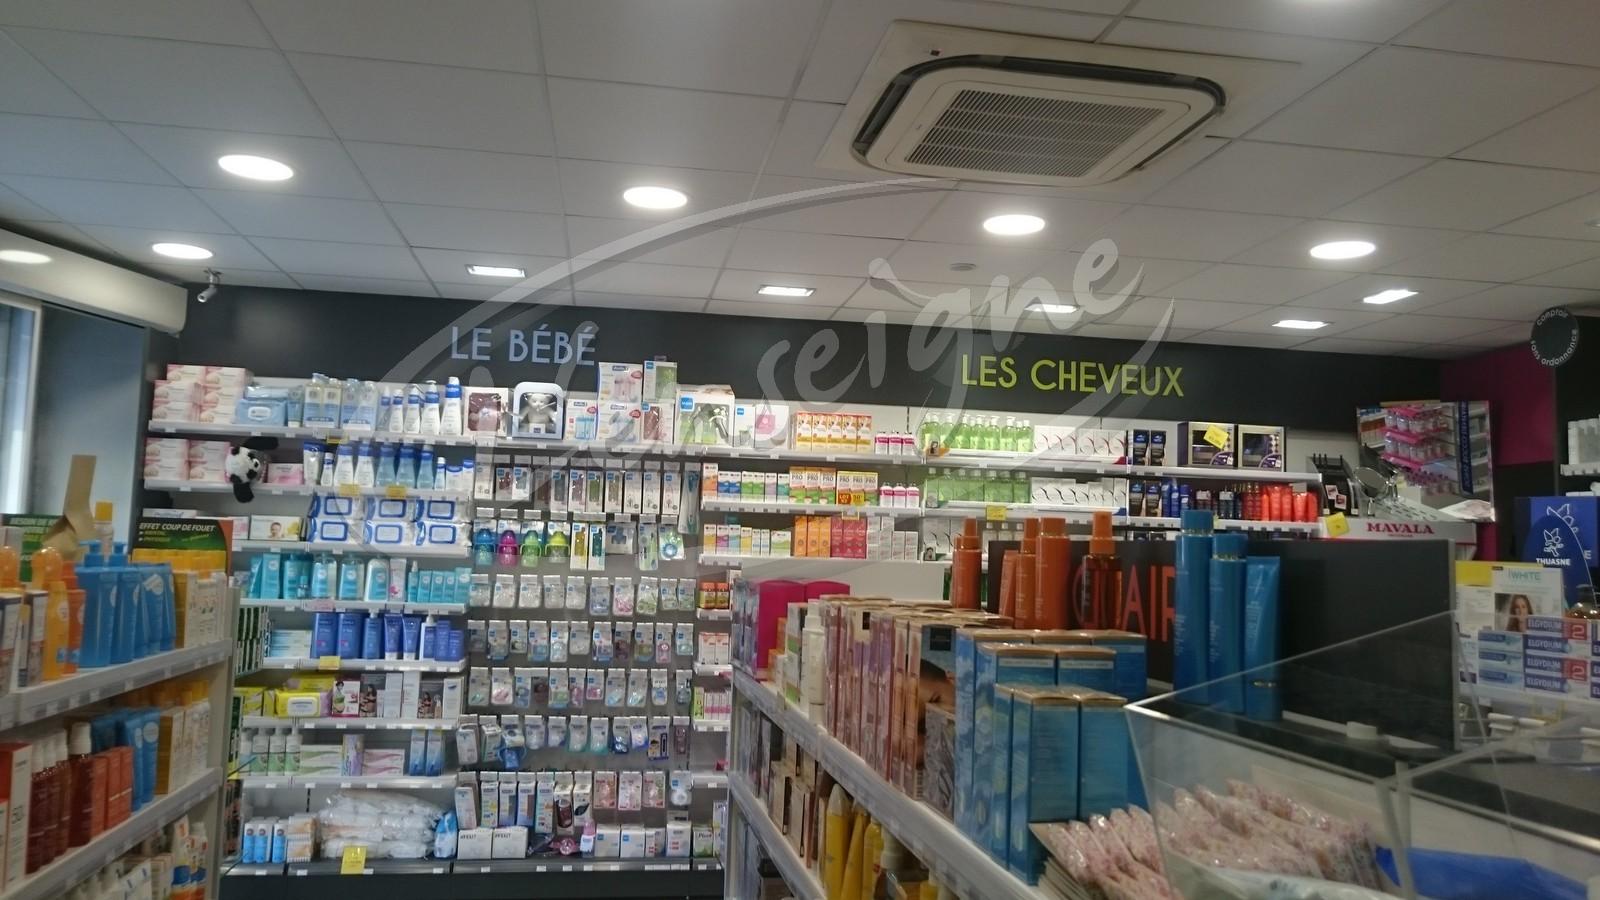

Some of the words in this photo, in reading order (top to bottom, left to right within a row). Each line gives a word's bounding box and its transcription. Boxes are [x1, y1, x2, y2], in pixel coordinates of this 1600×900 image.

[1537, 309, 1568, 326] comptoir
[451, 326, 492, 361] LE
[508, 323, 595, 366] BÉBÉ
[1541, 329, 1578, 366] ordonnance
[962, 354, 1018, 388] LES
[1031, 359, 1184, 397] CHEVEUX
[162, 523, 180, 531] COUP
[1367, 522, 1434, 534] MAVALA
[1536, 558, 1571, 566] THUASNE
[1571, 624, 1585, 639] 2
[1527, 639, 1562, 649] ELGYDIUM
[1571, 665, 1585, 680] 2
[1526, 677, 1561, 689] ELGYDIUM
